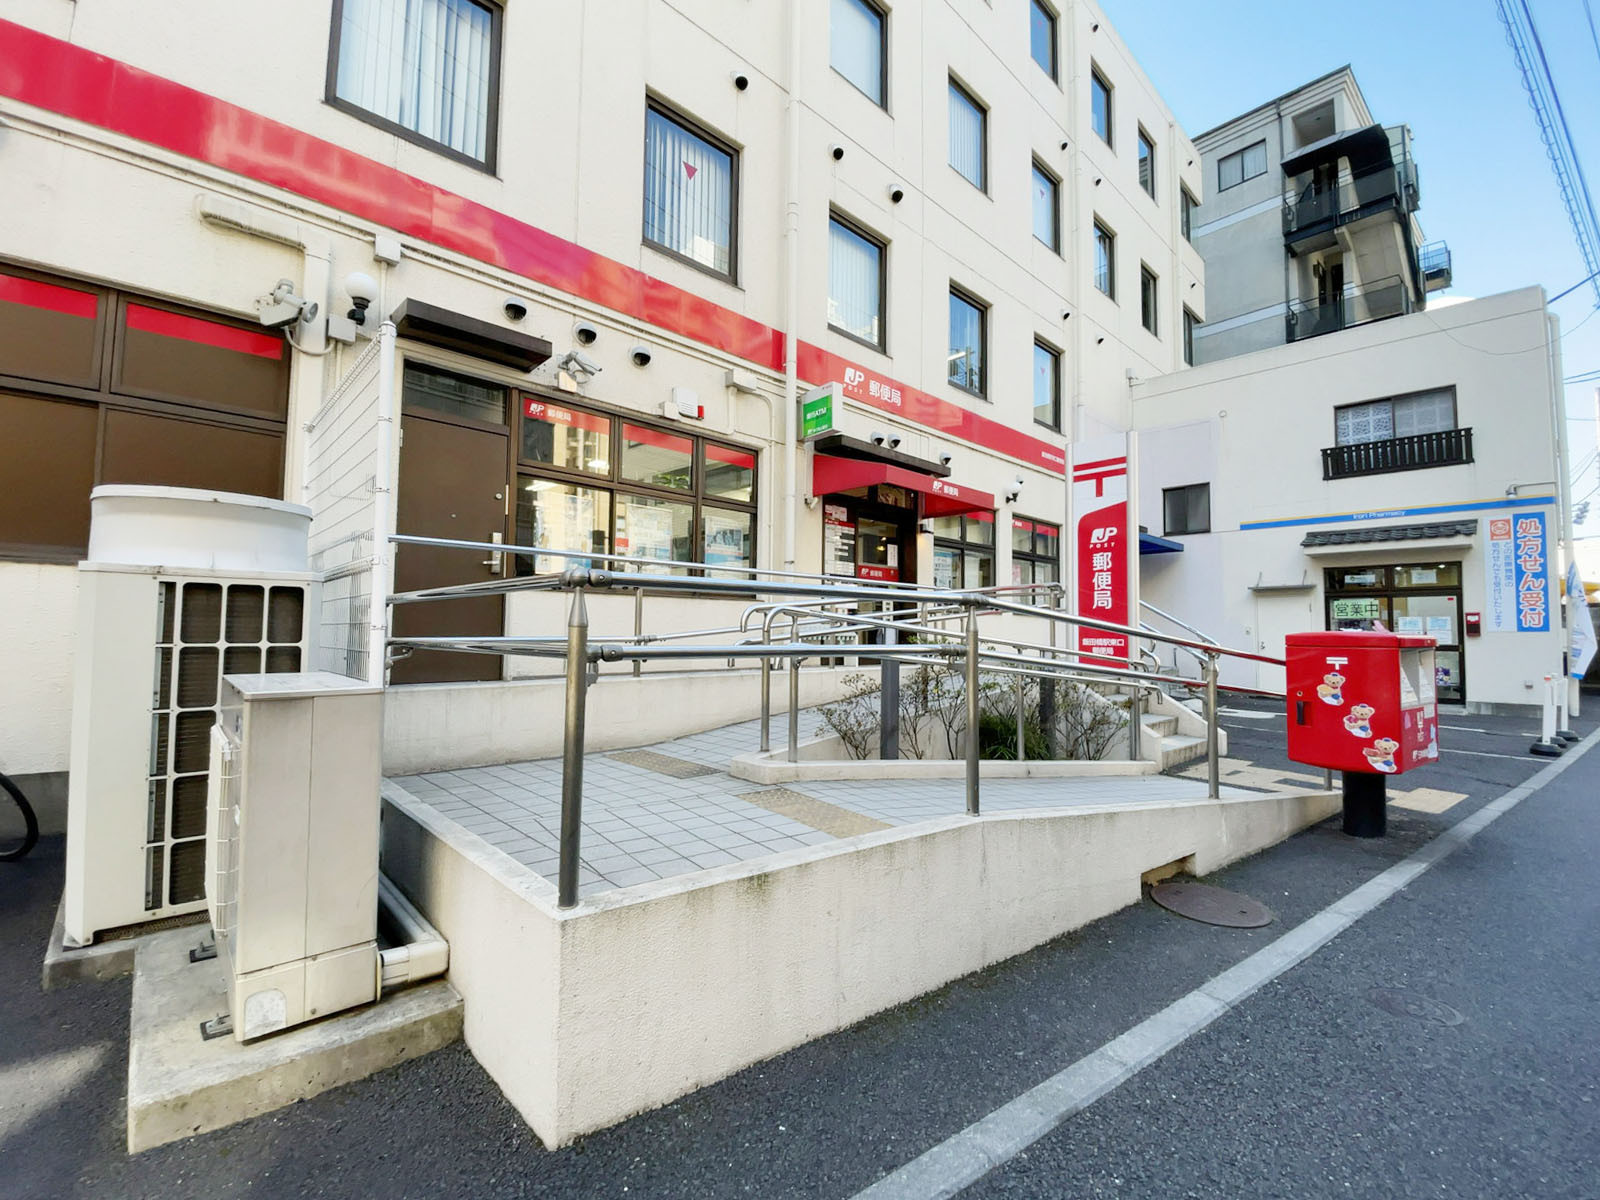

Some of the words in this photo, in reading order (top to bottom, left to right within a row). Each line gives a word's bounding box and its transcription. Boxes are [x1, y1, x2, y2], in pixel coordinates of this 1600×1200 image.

[844, 368, 864, 385] JP
[869, 380, 901, 406] 郵便局
[547, 408, 571, 421] 郵便局
[1090, 527, 1117, 543] JP
[1092, 552, 1112, 609] 郵便局
[1517, 518, 1544, 628] 処方せん受付
[1335, 601, 1379, 617] 営業中
